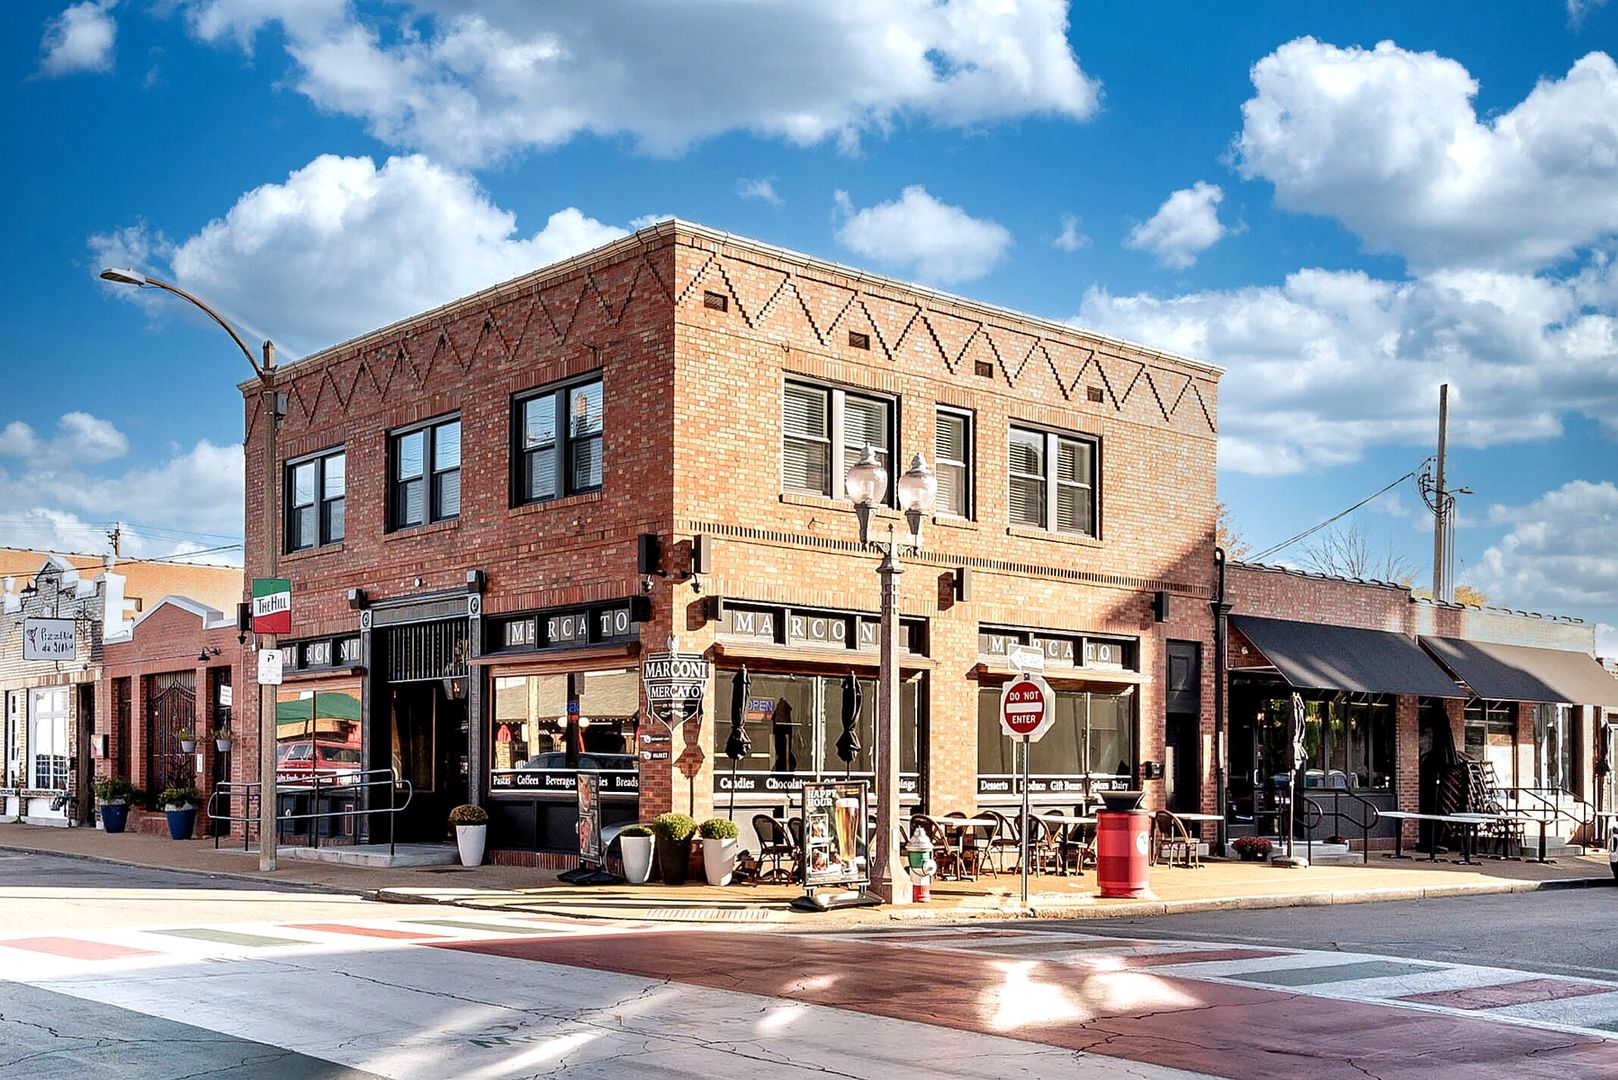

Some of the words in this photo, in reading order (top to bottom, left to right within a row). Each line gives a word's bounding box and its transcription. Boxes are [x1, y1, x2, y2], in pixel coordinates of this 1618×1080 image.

[736, 611, 874, 642] MARCON
[645, 661, 707, 678] MARCONI
[651, 686, 700, 698] MERCATO
[1009, 692, 1020, 701] DO
[1024, 691, 1039, 700] NOT
[1012, 714, 1036, 724] ENTER
[493, 775, 511, 786] Pastas
[517, 774, 539, 785] Coffees
[545, 775, 576, 788] Beverages
[616, 776, 639, 787] Breads
[766, 778, 810, 789] Chocolat
[1111, 780, 1128, 792] Dairy
[808, 789, 837, 798] HAPPY
[808, 798, 833, 807] HOUR
